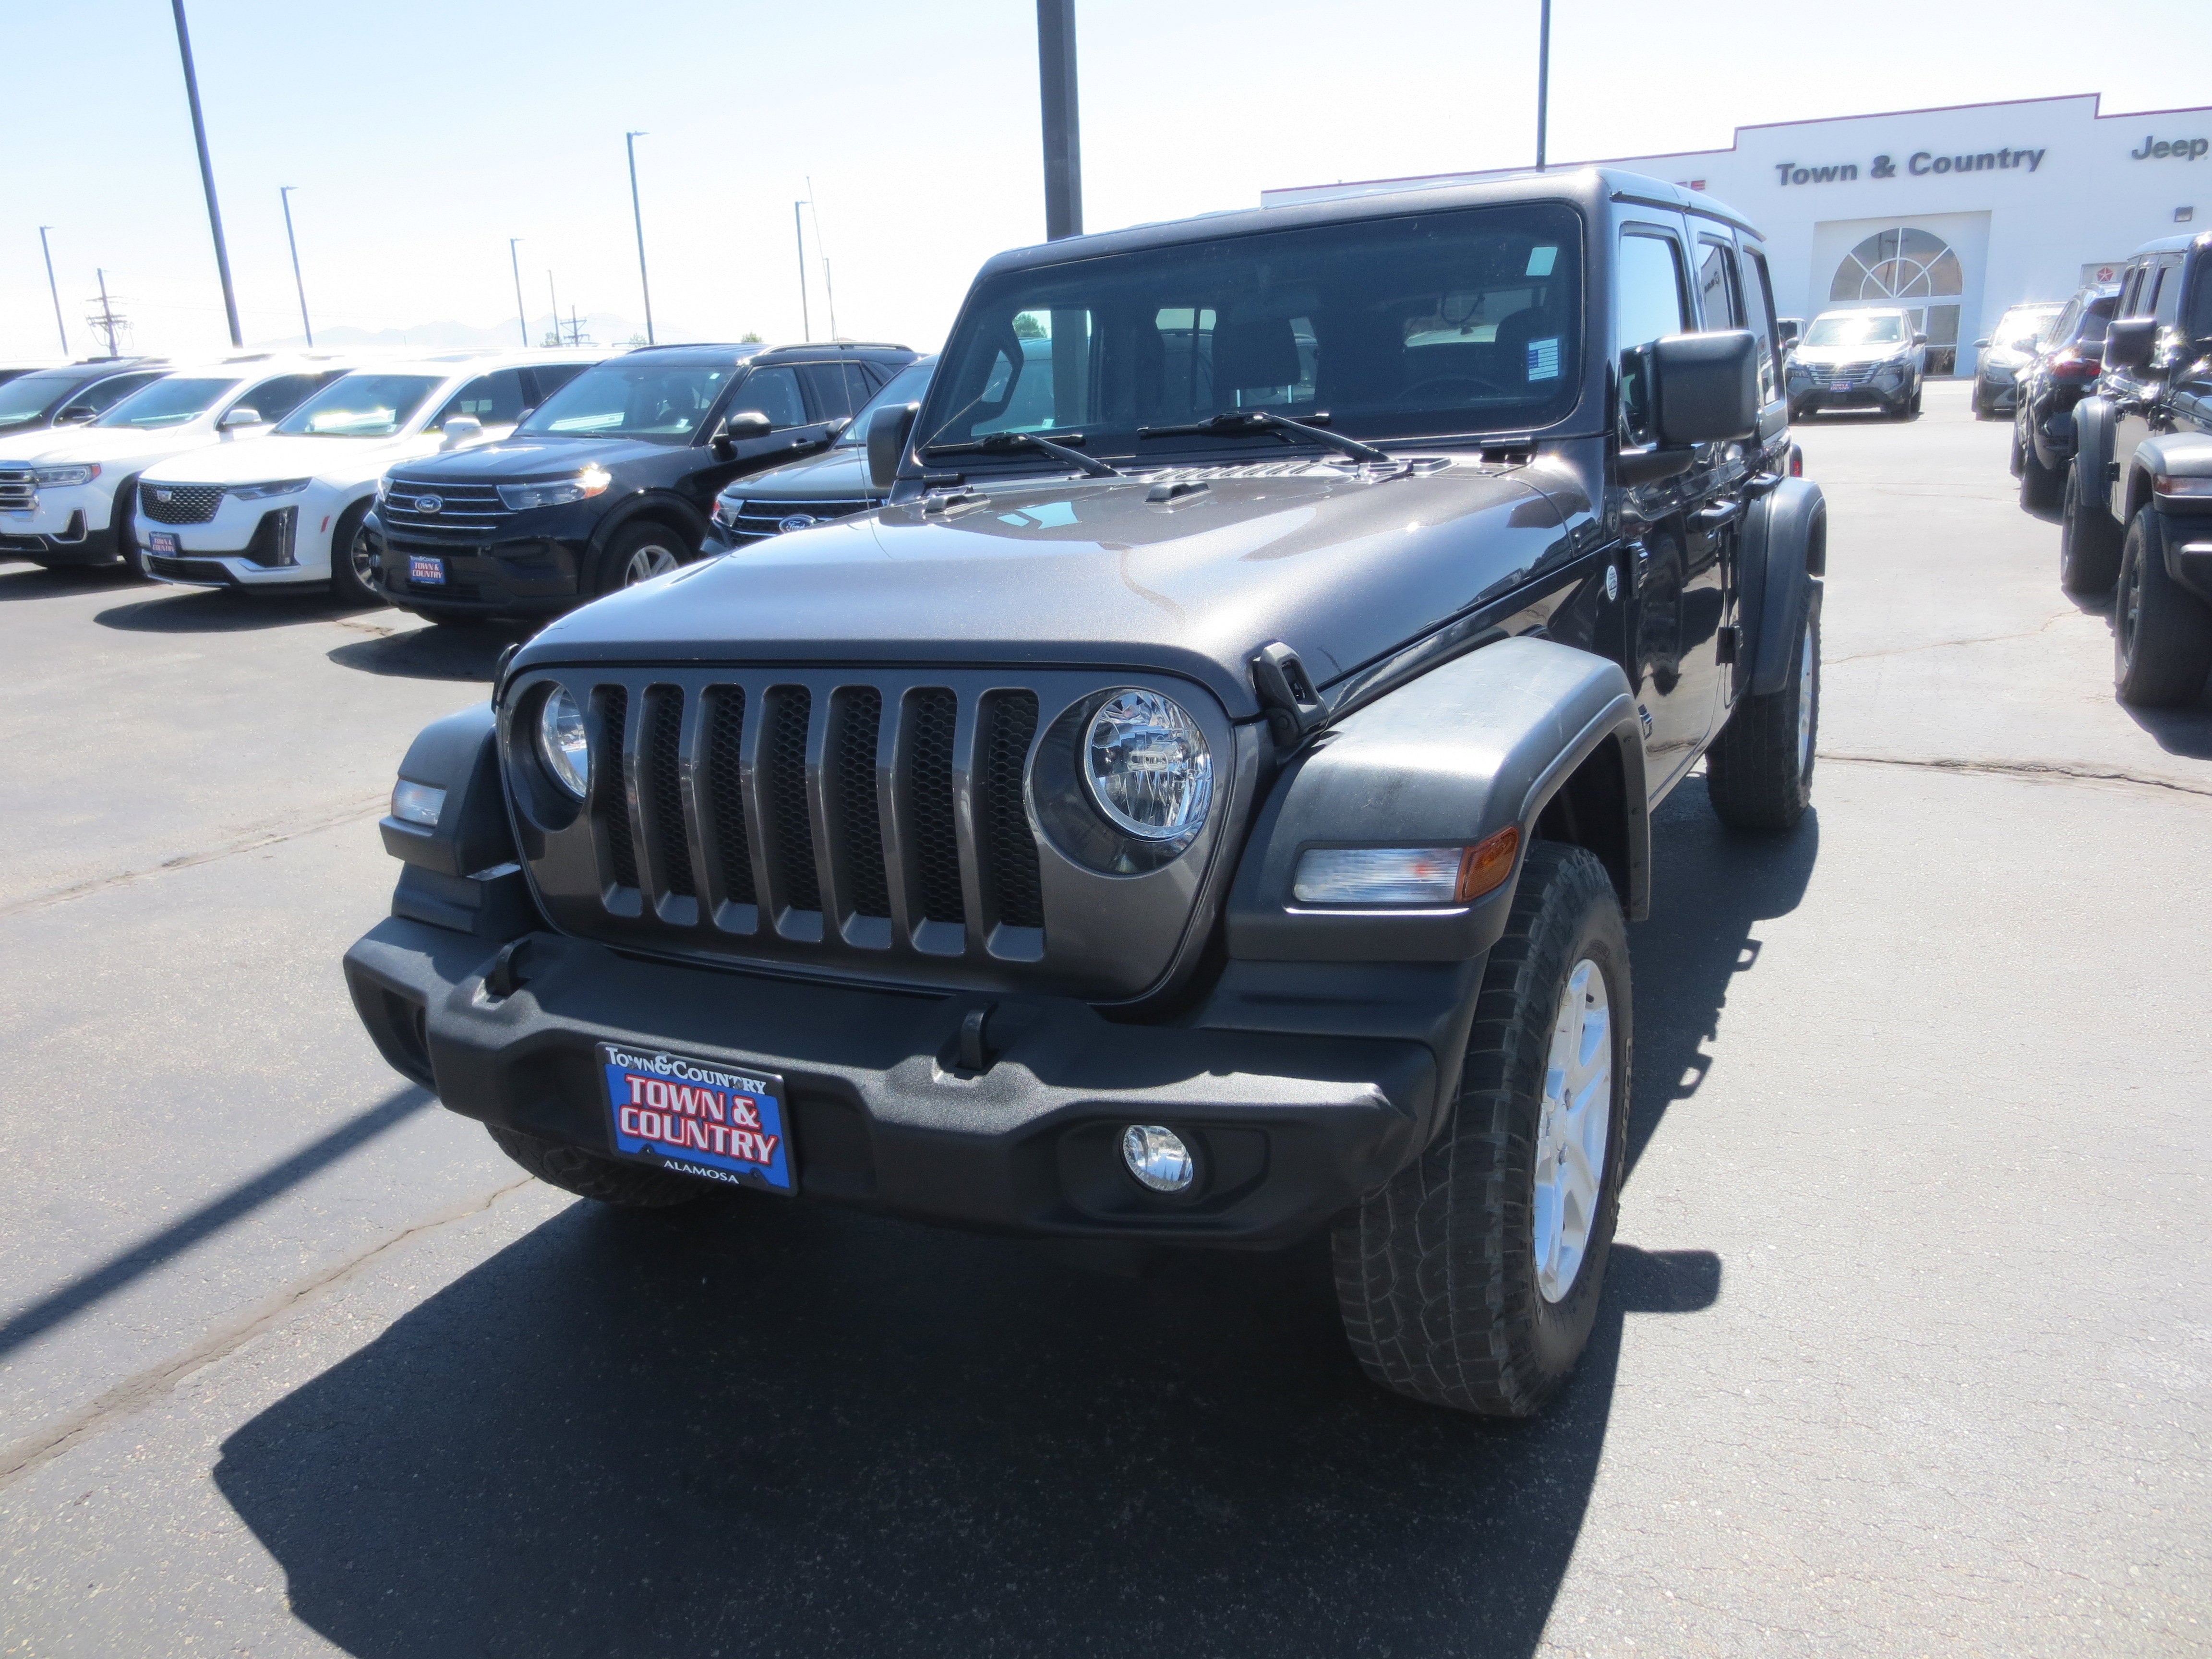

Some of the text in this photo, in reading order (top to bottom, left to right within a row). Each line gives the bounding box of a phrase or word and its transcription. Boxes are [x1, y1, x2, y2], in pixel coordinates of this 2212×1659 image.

[2132, 135, 2208, 161] Jeep
[1776, 148, 2046, 186] Town & Country
[786, 520, 806, 531] Ford
[412, 569, 443, 579] COUNTRY
[414, 562, 433, 571] TOWN
[625, 1074, 761, 1129] TOWN &
[619, 1105, 780, 1166] COUNTRY
[663, 1160, 740, 1185] ALAMOSA
